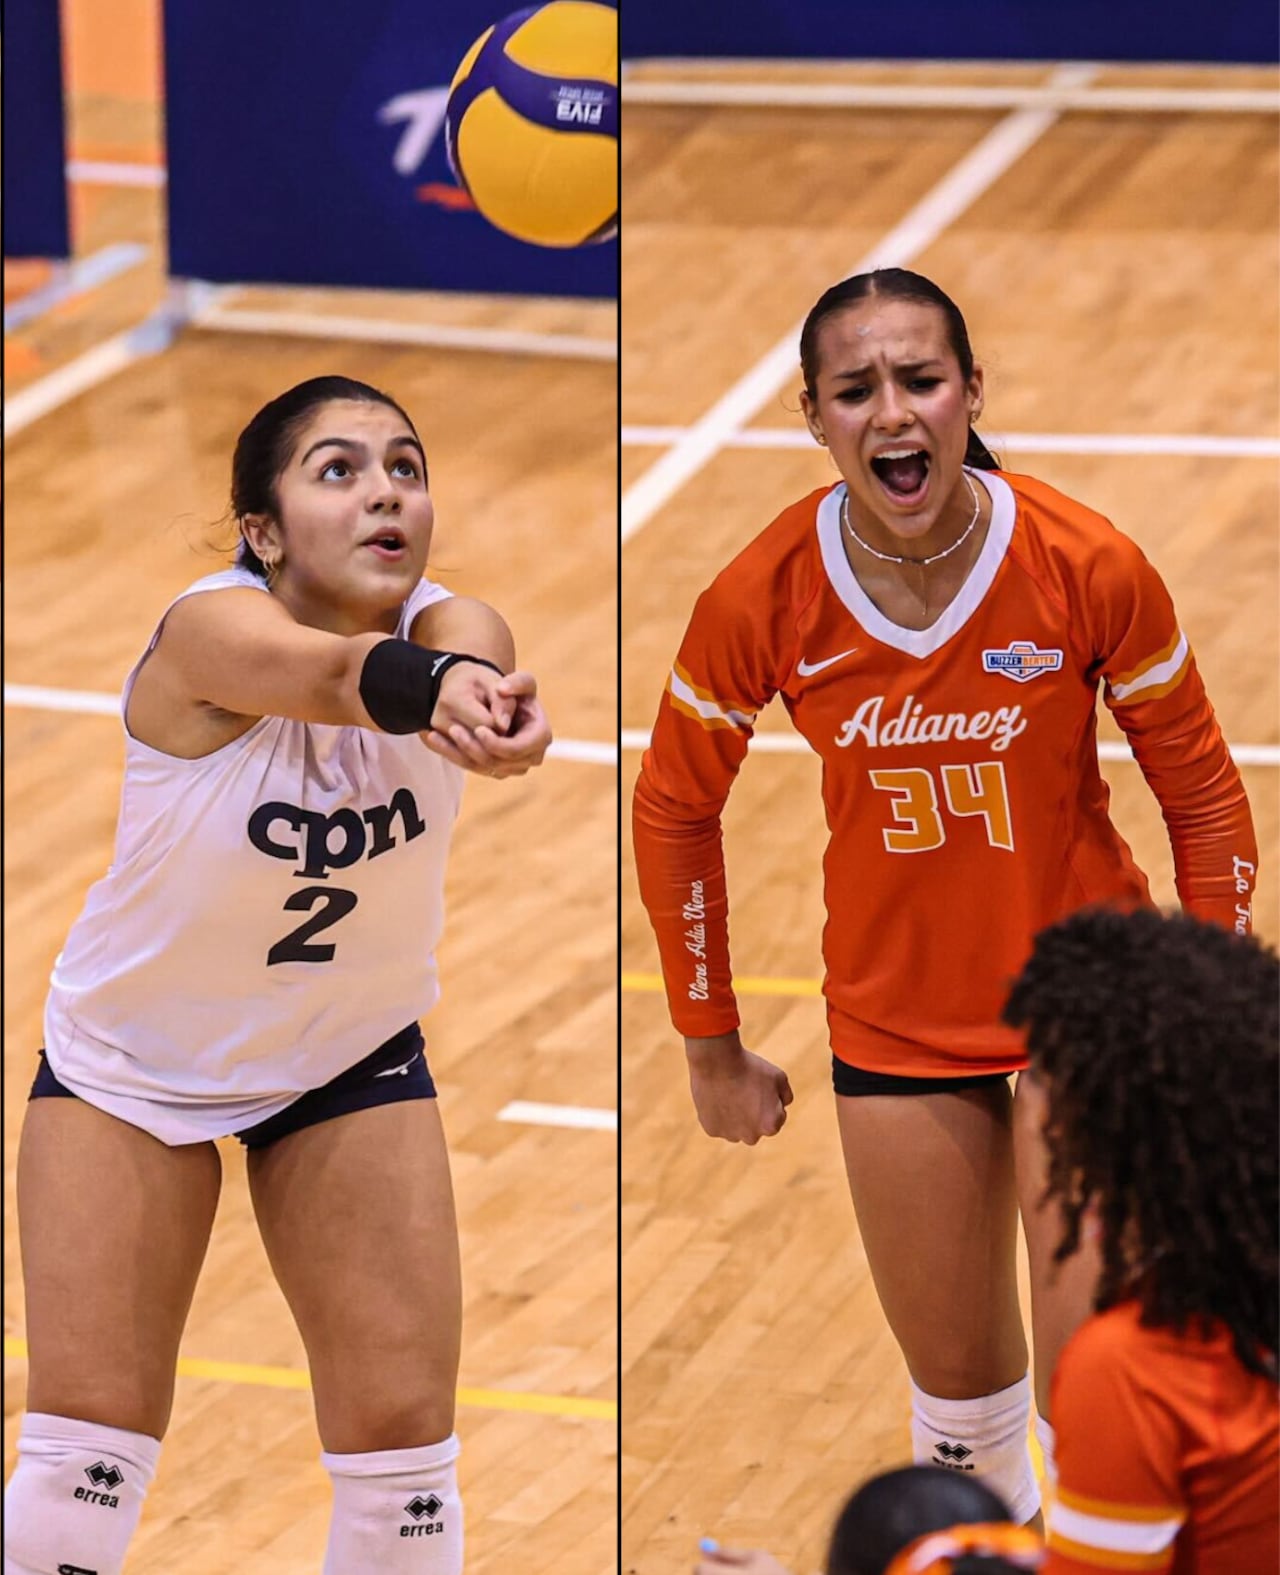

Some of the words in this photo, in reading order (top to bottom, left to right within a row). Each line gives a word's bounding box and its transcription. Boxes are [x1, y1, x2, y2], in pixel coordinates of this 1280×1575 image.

[834, 695, 1027, 751] Adianez
[247, 788, 426, 879] cpn
[868, 761, 1015, 852] 34
[266, 886, 358, 967] 2
[73, 1486, 120, 1509] errea
[400, 1521, 444, 1537] errea
